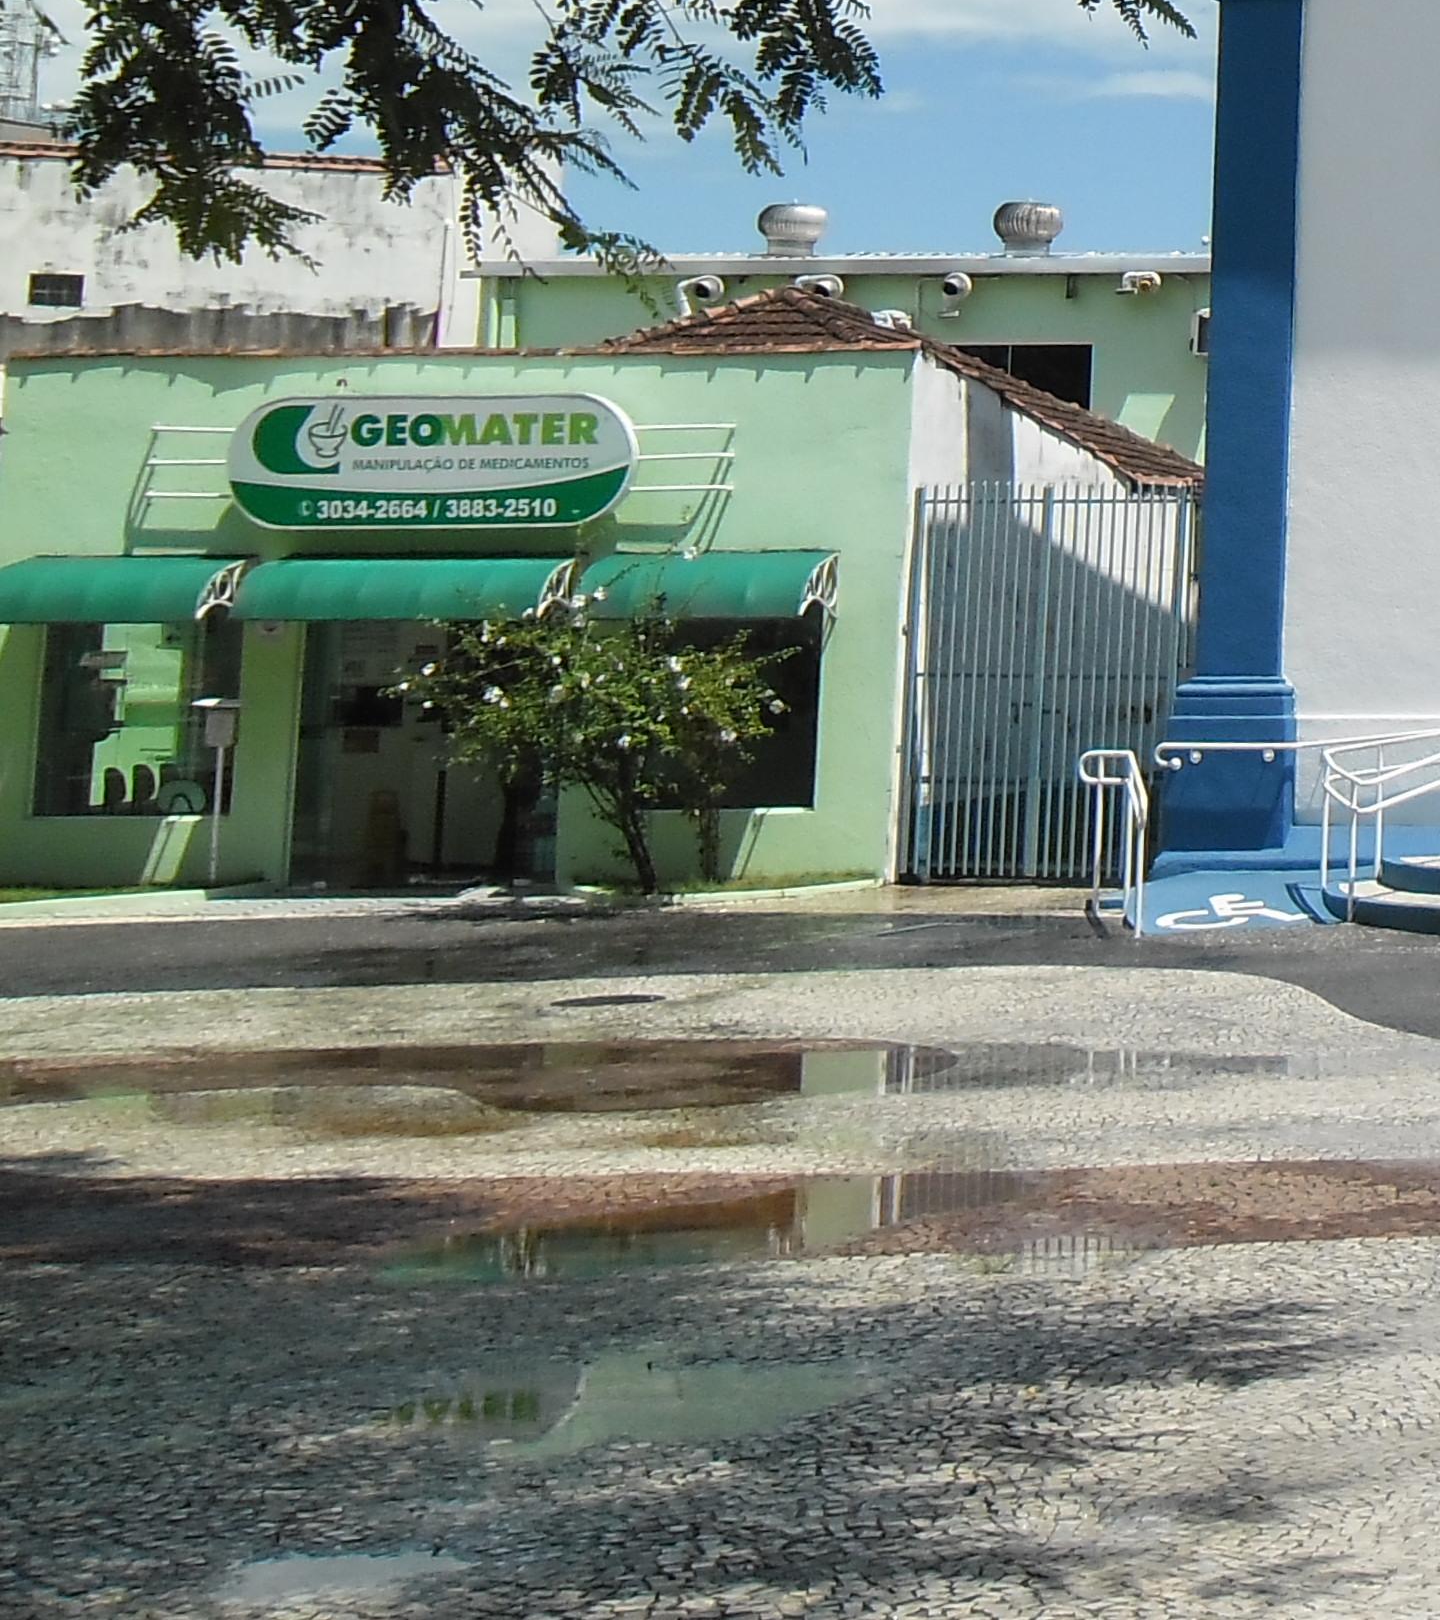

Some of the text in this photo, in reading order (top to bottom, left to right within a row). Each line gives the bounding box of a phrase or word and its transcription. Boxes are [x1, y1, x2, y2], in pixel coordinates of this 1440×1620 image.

[350, 412, 599, 447] GEOMATER
[352, 456, 589, 473] MANIPULAÇÃO DE MEDICAMENTOS
[317, 499, 428, 519] 3034-2664
[445, 498, 557, 518] 3883-2510
